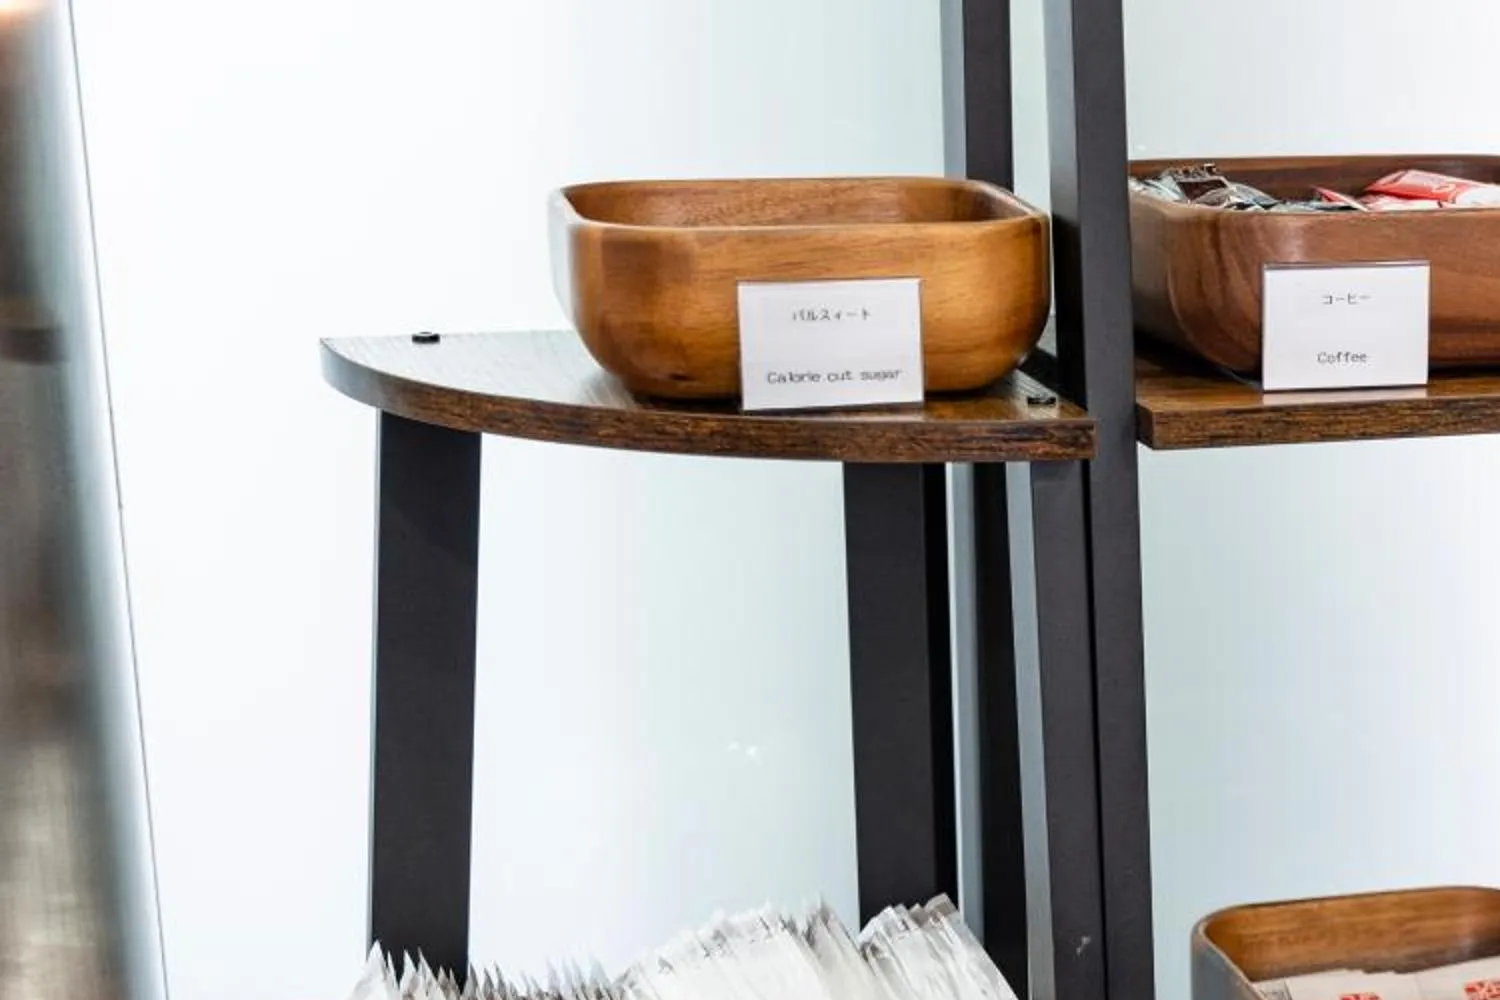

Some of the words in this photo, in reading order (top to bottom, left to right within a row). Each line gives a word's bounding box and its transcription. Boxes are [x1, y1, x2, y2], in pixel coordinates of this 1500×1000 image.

[1323, 292, 1370, 305] コーヒー
[1316, 351, 1368, 365] Coffee
[766, 371, 822, 385] Calorie
[826, 369, 854, 383] cut
[859, 369, 903, 382] sugar
